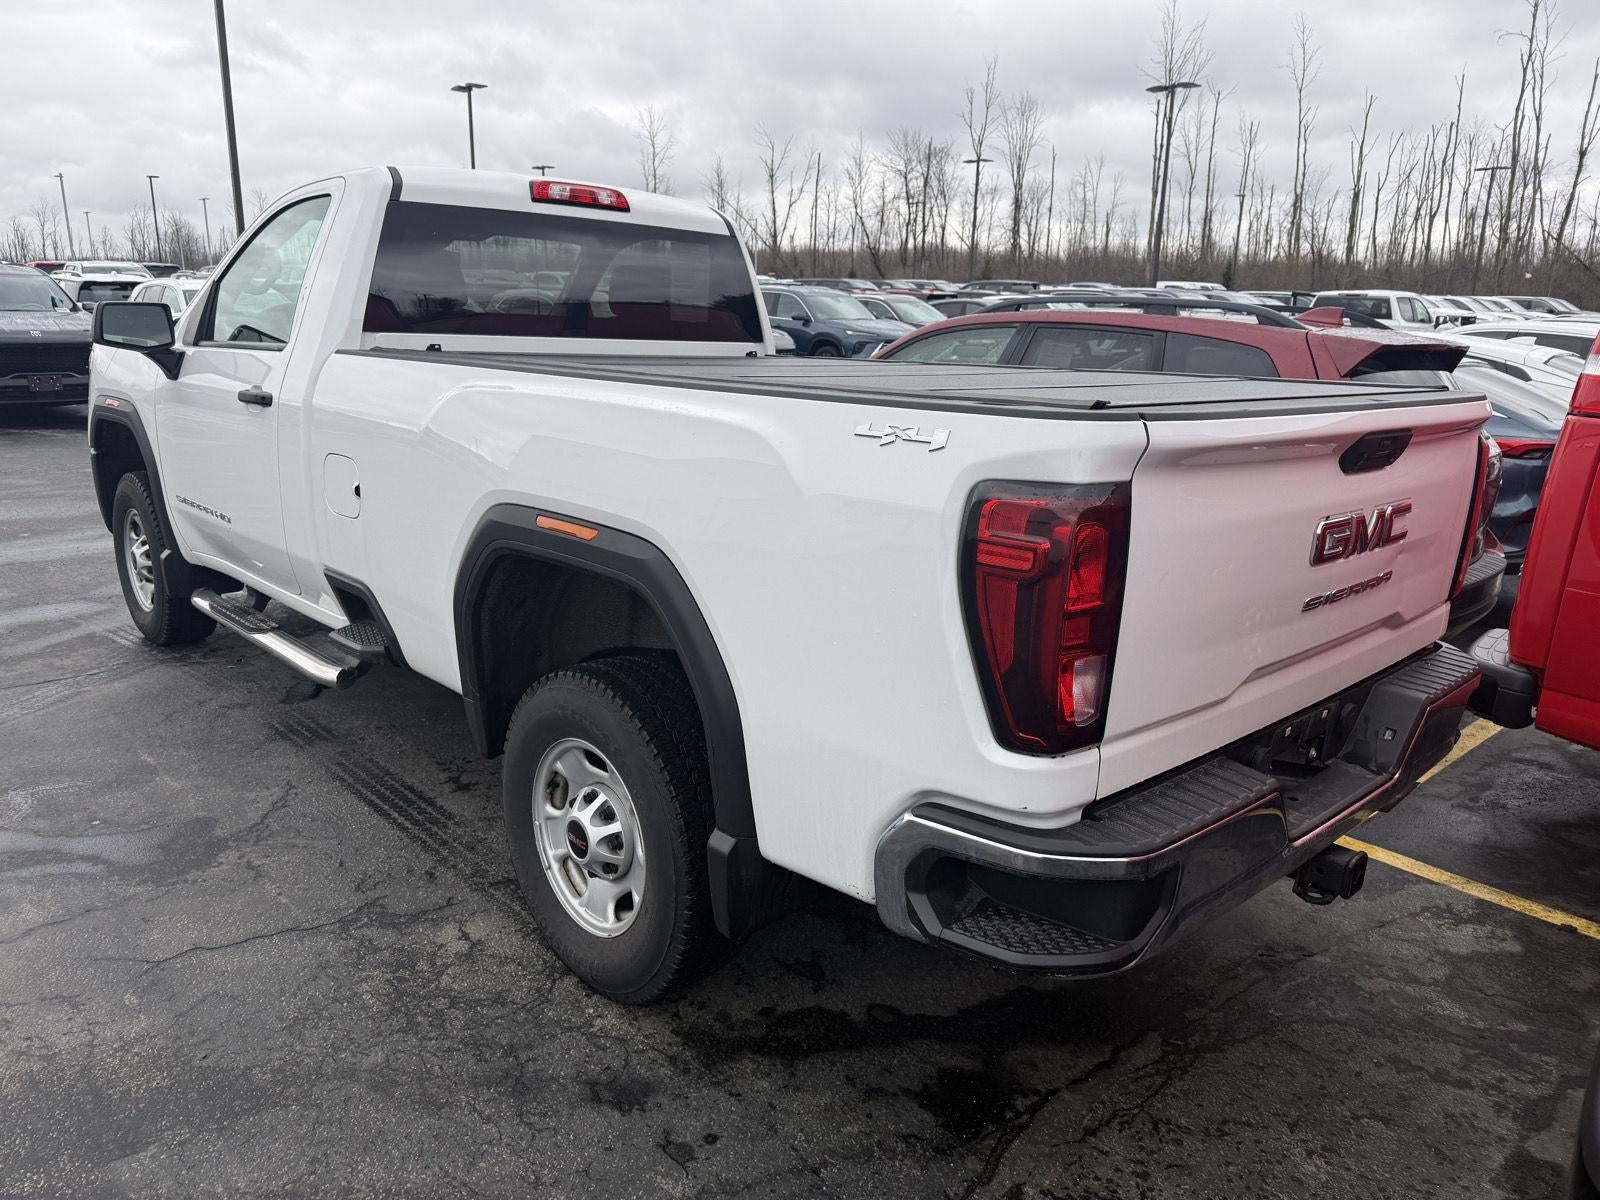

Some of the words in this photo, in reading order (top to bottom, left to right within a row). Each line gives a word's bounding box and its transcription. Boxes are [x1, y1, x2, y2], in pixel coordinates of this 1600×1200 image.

[1309, 497, 1412, 567] GMC
[1302, 570, 1393, 613] SIERRA
[567, 832, 587, 850] GMC
